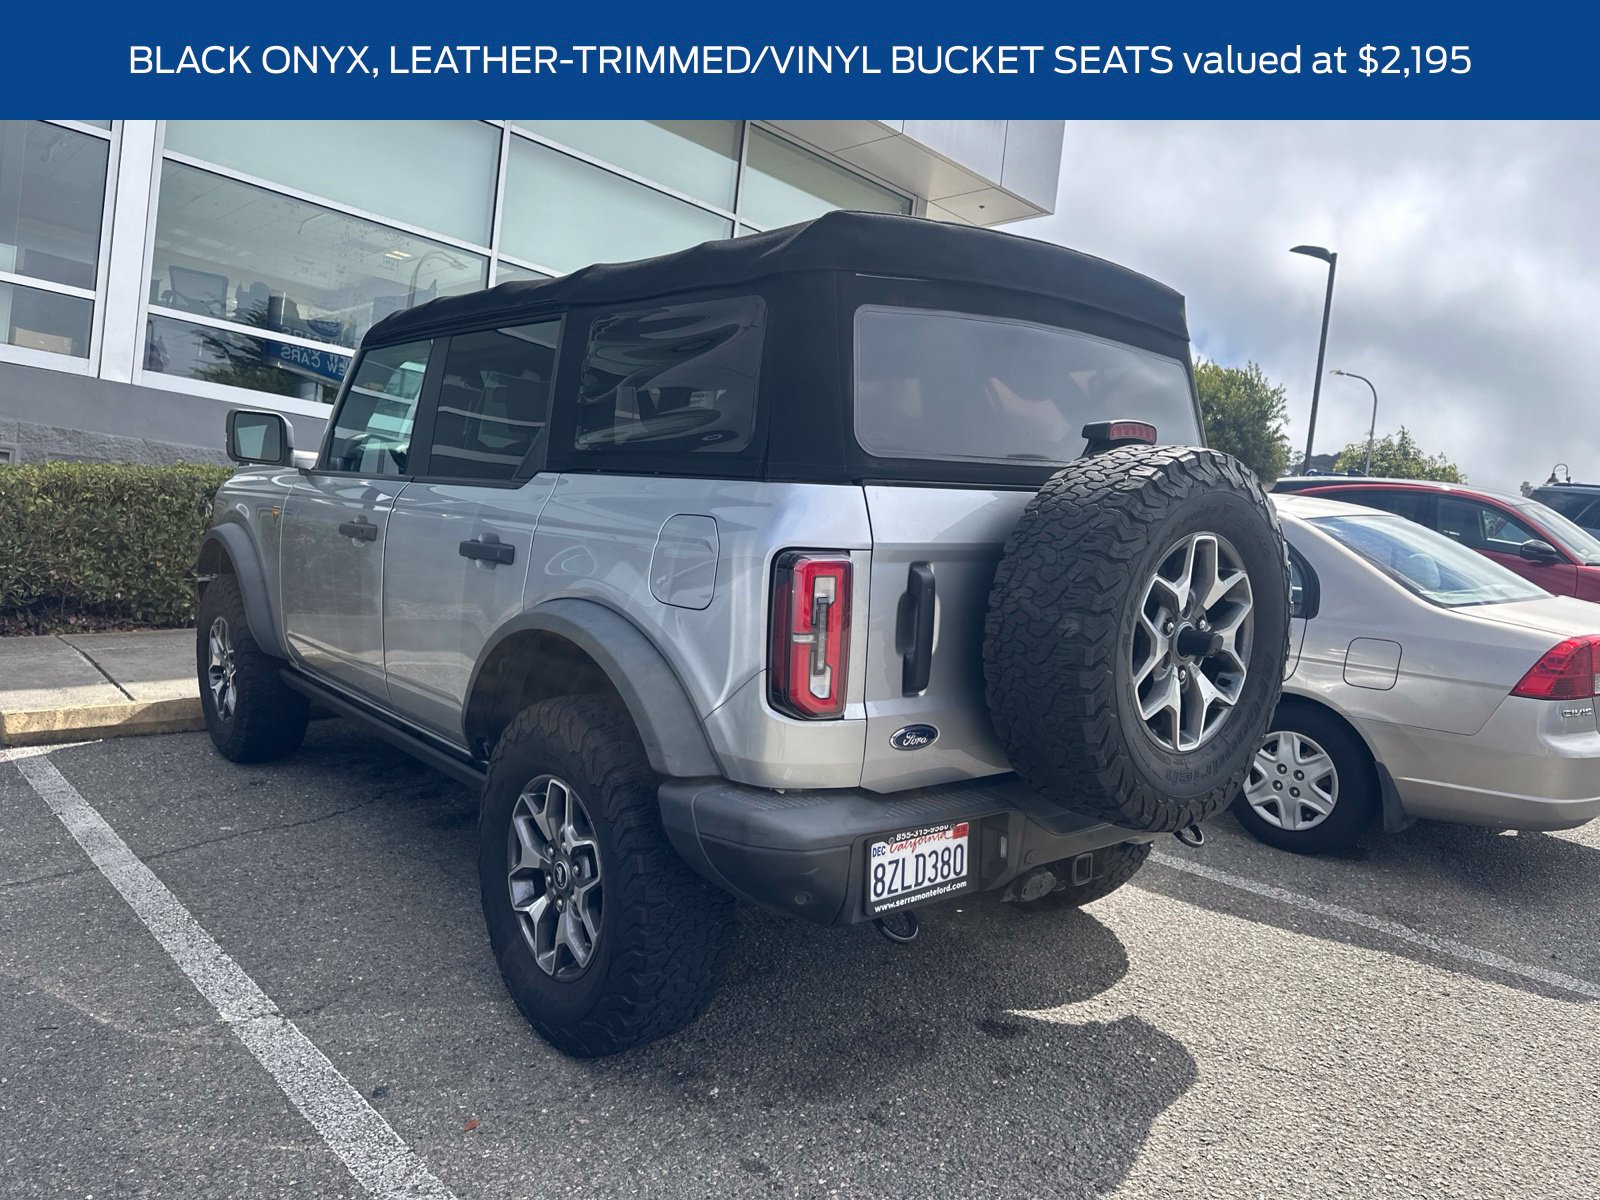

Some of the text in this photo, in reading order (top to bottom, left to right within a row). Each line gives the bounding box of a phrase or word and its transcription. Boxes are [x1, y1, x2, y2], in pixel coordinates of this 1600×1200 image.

[872, 845, 886, 857] DEC
[889, 830, 952, 854] California
[873, 843, 965, 898] 8ZLD380
[874, 880, 967, 913] www.serramonteford.com
